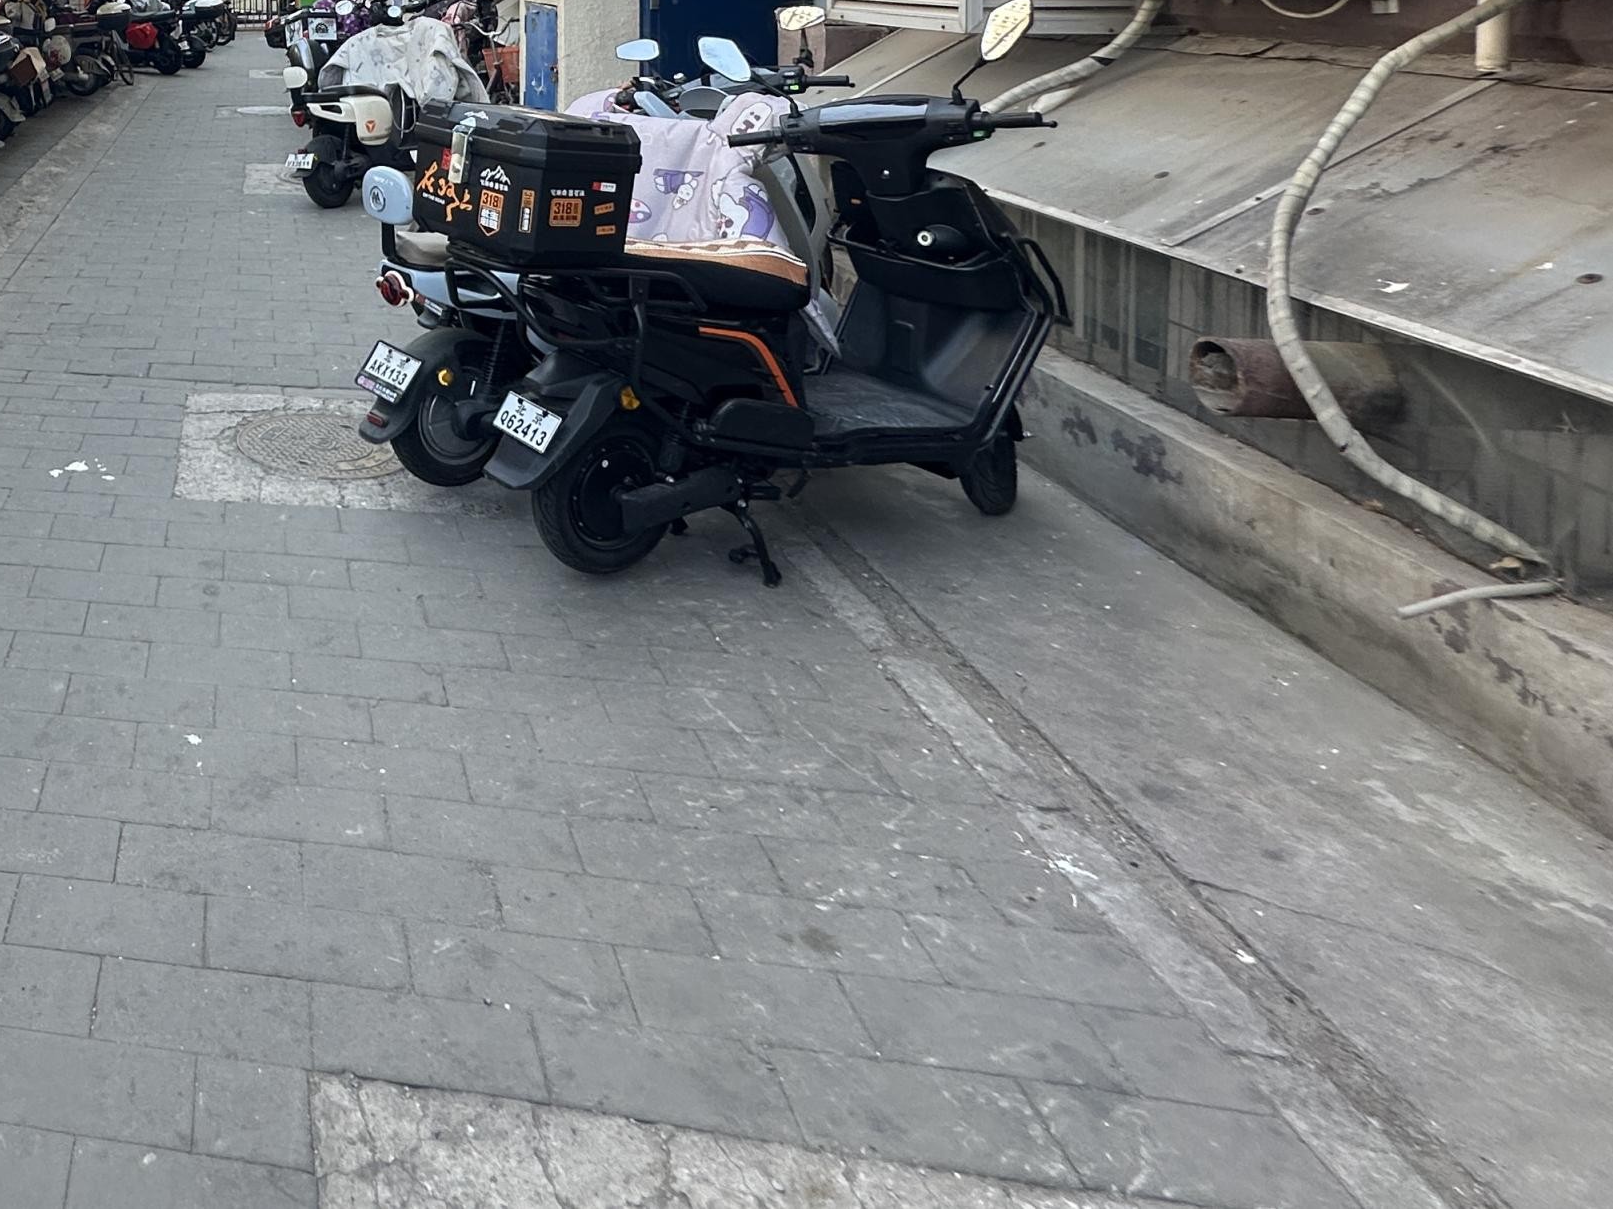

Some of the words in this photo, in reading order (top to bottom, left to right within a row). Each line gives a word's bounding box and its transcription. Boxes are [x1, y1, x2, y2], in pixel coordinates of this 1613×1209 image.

[482, 192, 499, 208] 318
[553, 202, 573, 215] 318
[368, 358, 408, 386] AKX133
[499, 409, 548, 448] Q62413
